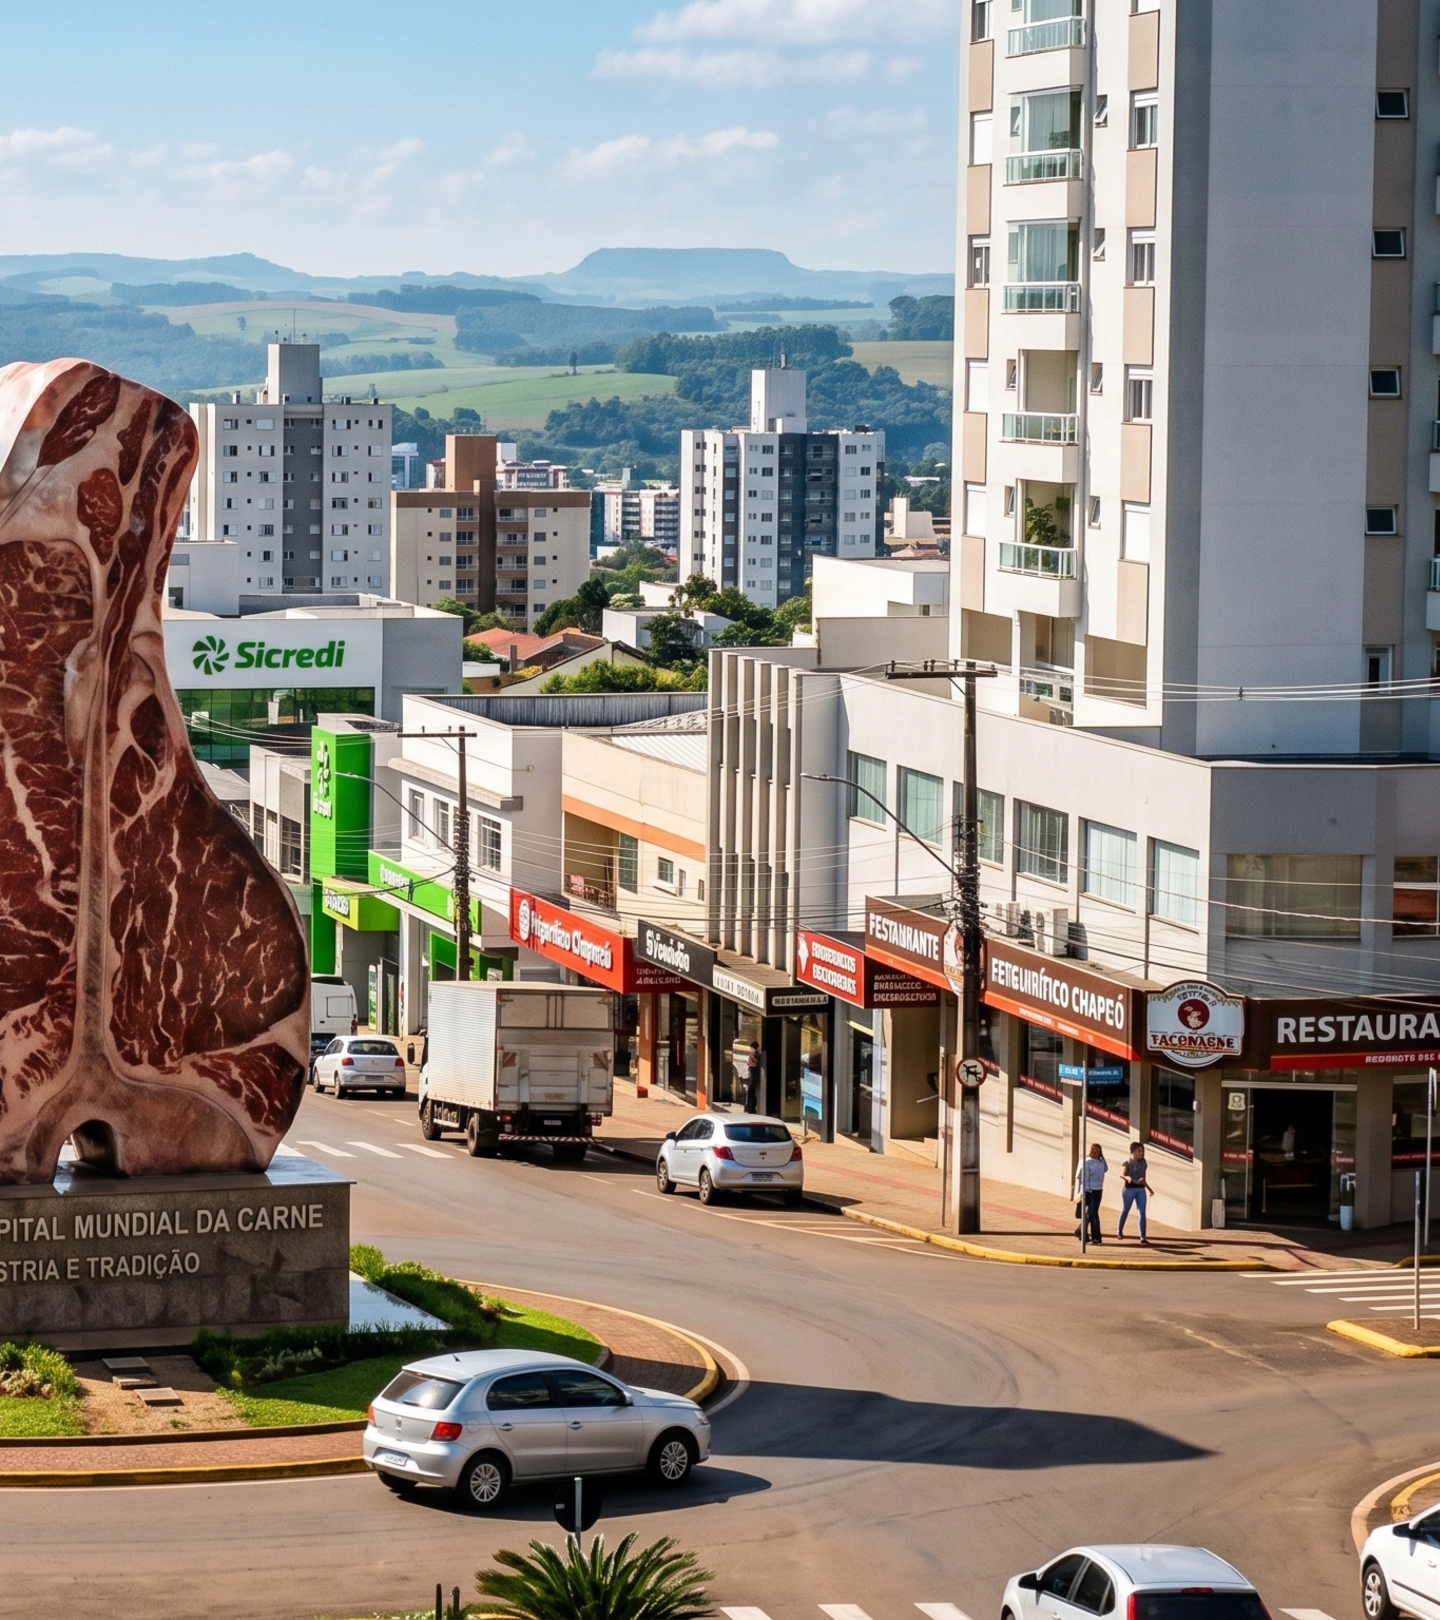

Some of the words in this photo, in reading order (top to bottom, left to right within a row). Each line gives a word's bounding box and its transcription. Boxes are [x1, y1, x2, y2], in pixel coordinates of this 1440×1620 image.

[234, 640, 345, 669] Sicredi
[1277, 1012, 1440, 1044] RESTAURA
[74, 1210, 189, 1239] MUNDIAL
[196, 1208, 231, 1233] DA
[237, 1203, 324, 1232] CARNE
[66, 1257, 80, 1279] E
[86, 1248, 200, 1280] TRADIÇÃO
